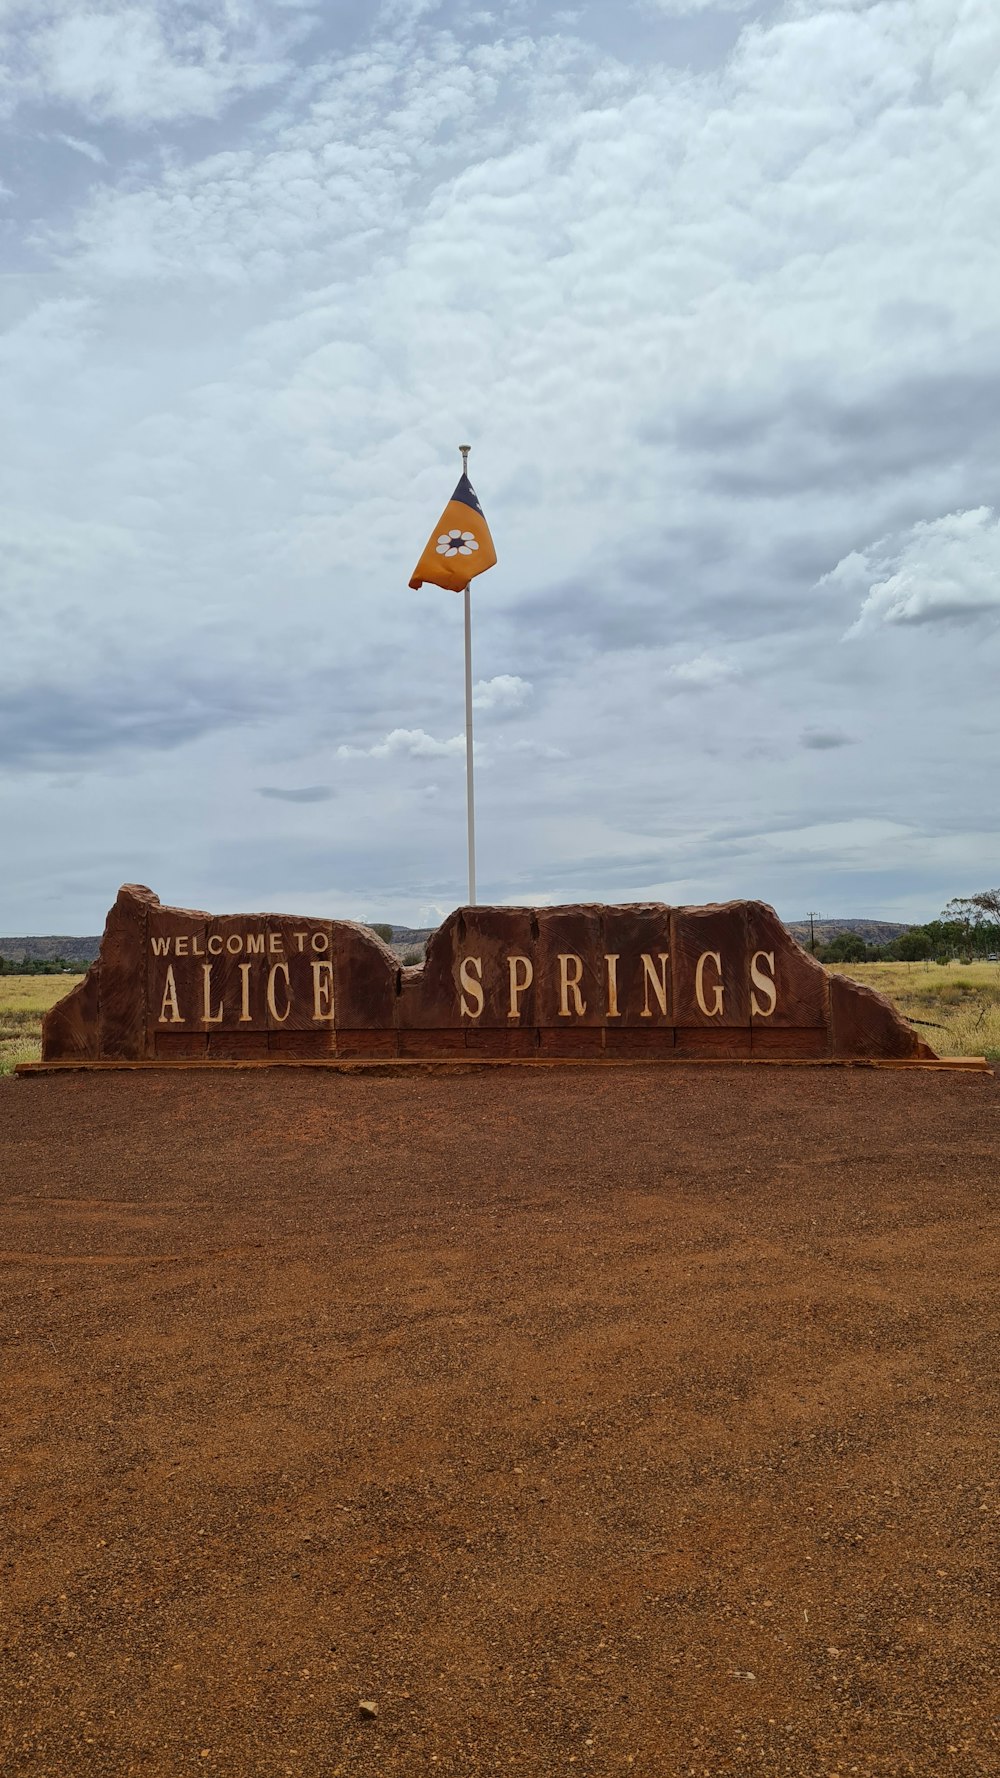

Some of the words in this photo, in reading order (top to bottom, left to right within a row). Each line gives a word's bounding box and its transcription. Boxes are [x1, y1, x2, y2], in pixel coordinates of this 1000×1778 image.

[150, 932, 284, 957] WELCOME
[293, 931, 329, 953] TO
[158, 960, 335, 1023] ALICE
[459, 950, 778, 1019] SPRINGS
